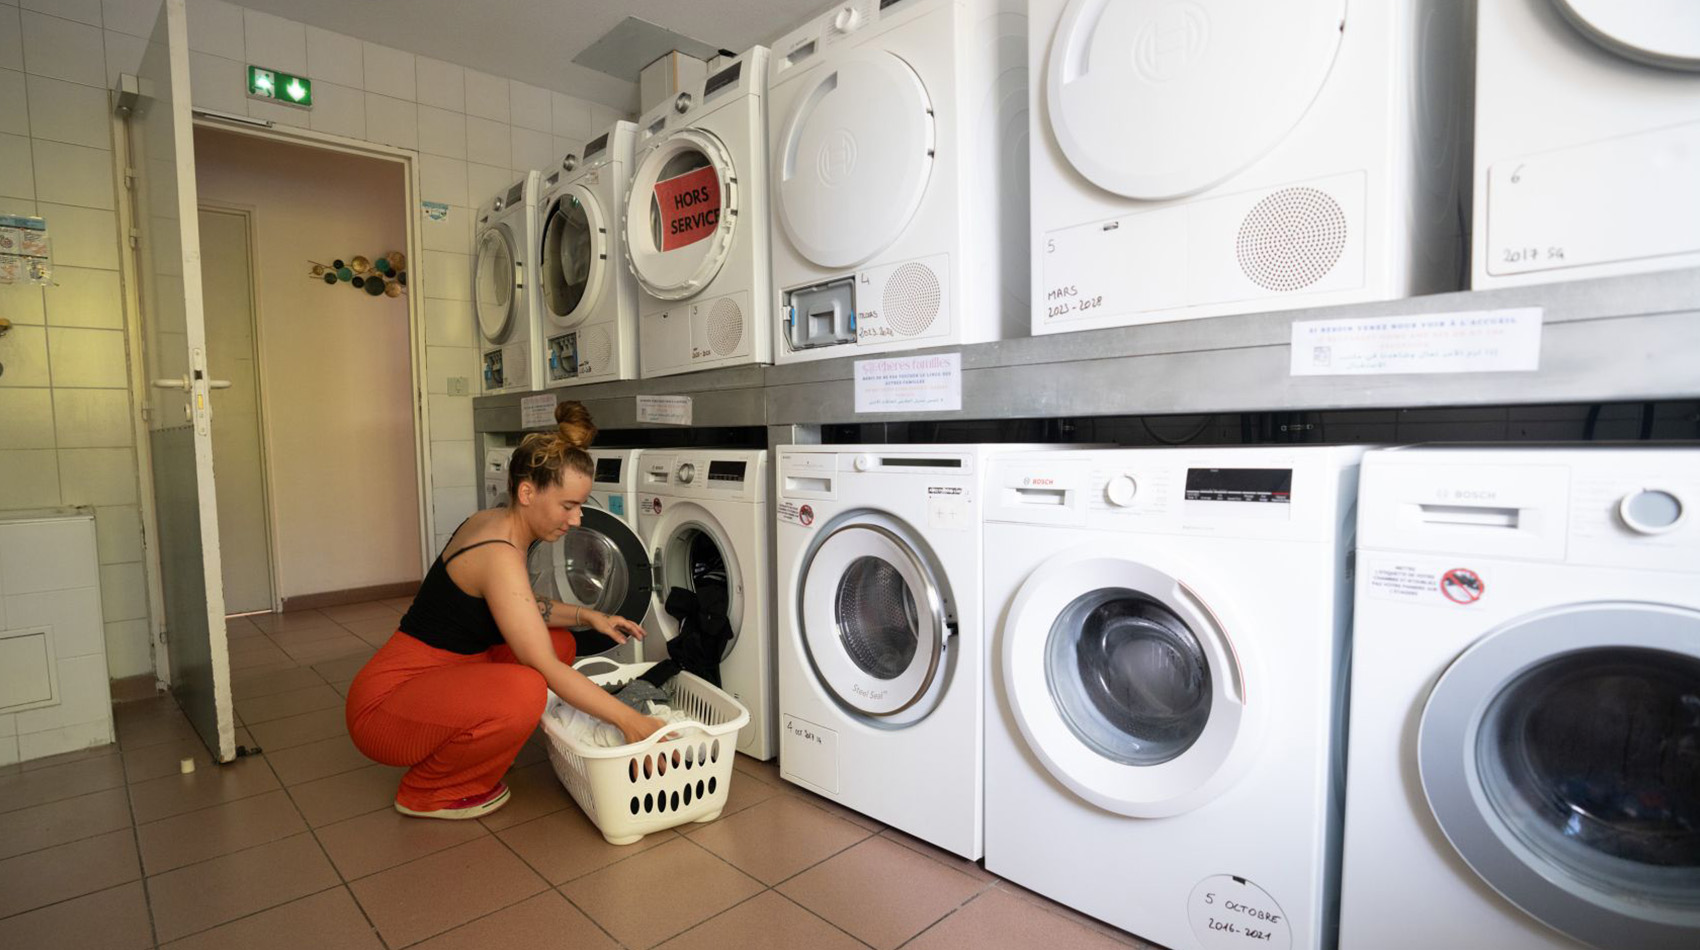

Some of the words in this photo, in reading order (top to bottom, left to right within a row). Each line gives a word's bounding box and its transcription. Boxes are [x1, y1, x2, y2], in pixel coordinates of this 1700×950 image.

[674, 186, 710, 210] HORS
[671, 208, 720, 235] SERVICE
[1047, 238, 1056, 254] 5
[1047, 285, 1078, 300] MARS
[1455, 490, 1497, 500] BOSCH
[1205, 892, 1215, 905] 5
[1225, 900, 1281, 924] OCTOBRE
